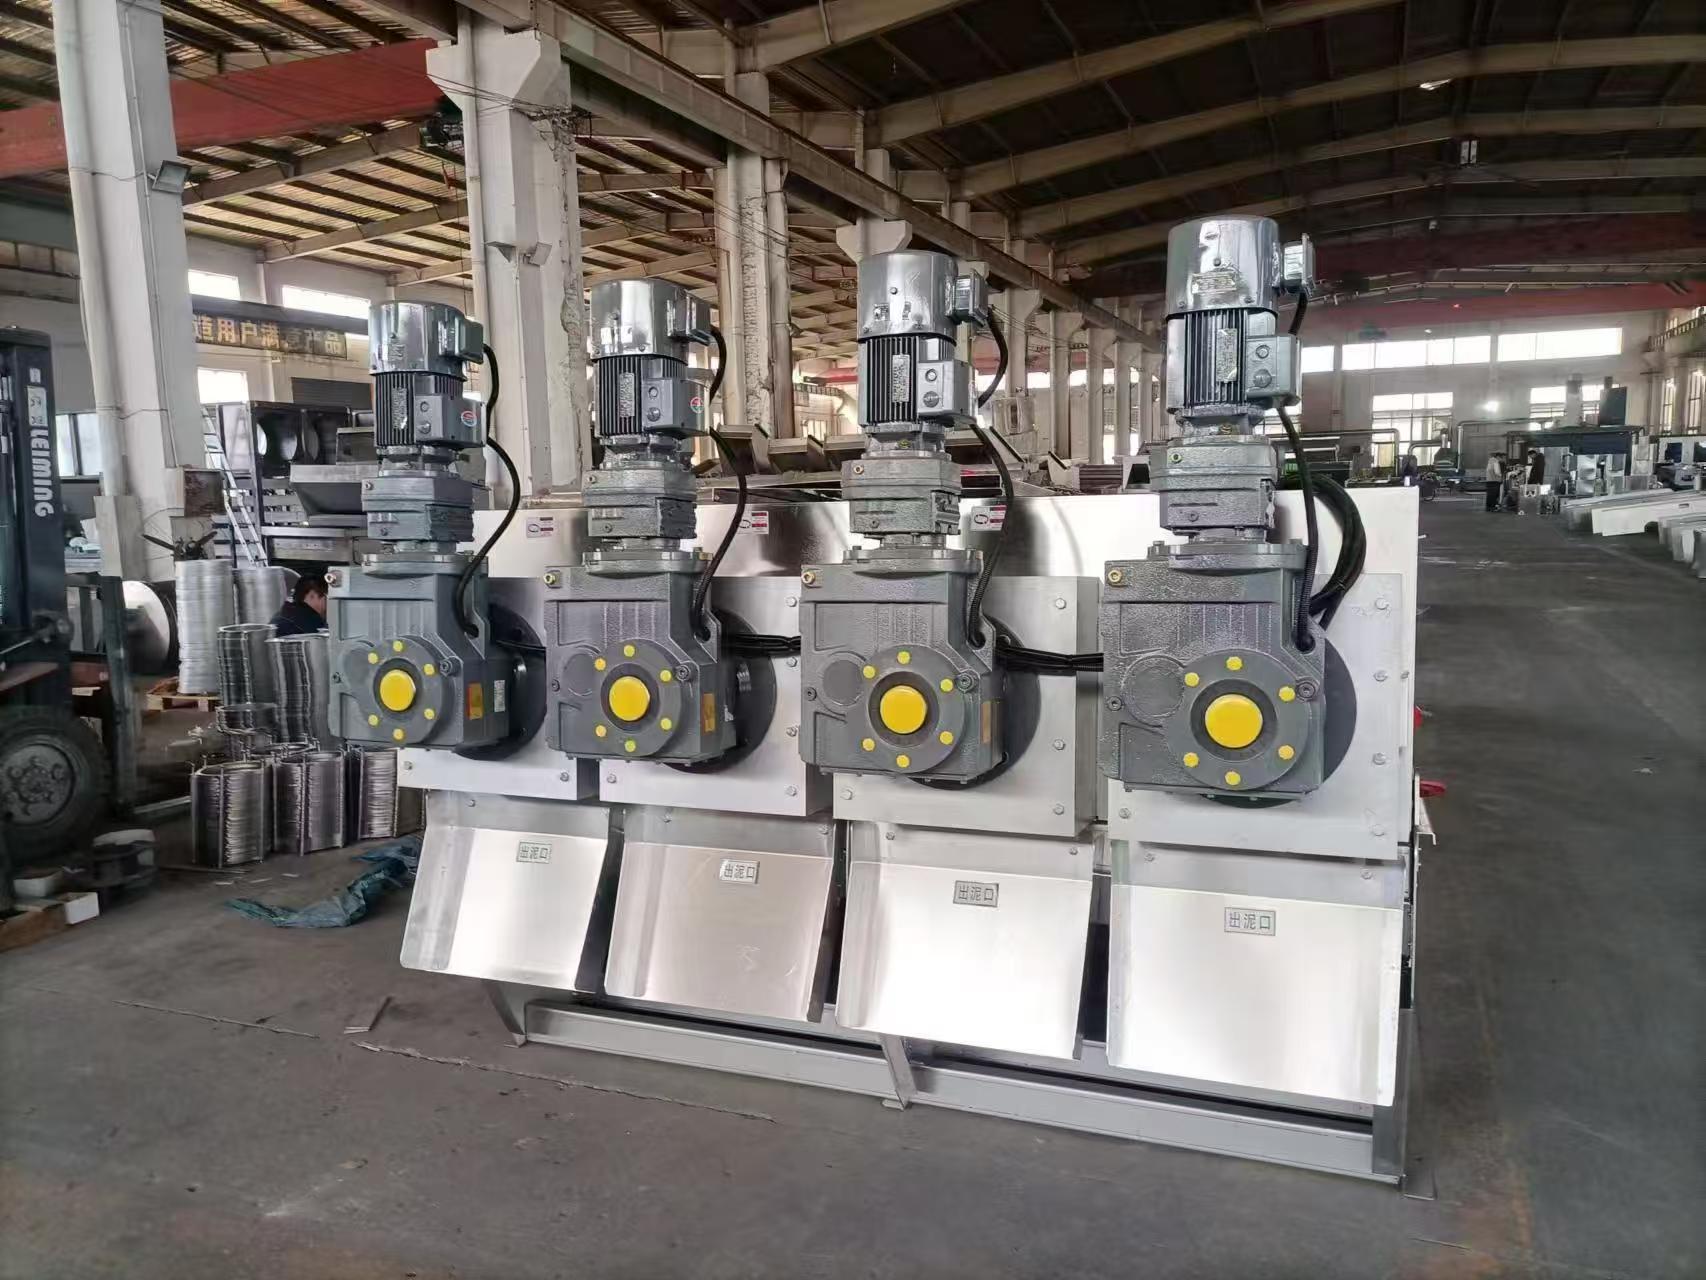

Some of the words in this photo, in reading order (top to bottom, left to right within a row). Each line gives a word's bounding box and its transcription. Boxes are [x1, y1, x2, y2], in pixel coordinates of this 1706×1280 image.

[519, 844, 549, 859] 出泥口
[724, 863, 755, 878] 出泥口
[958, 885, 994, 901] 出泥口
[1229, 911, 1271, 929] 出泥口
